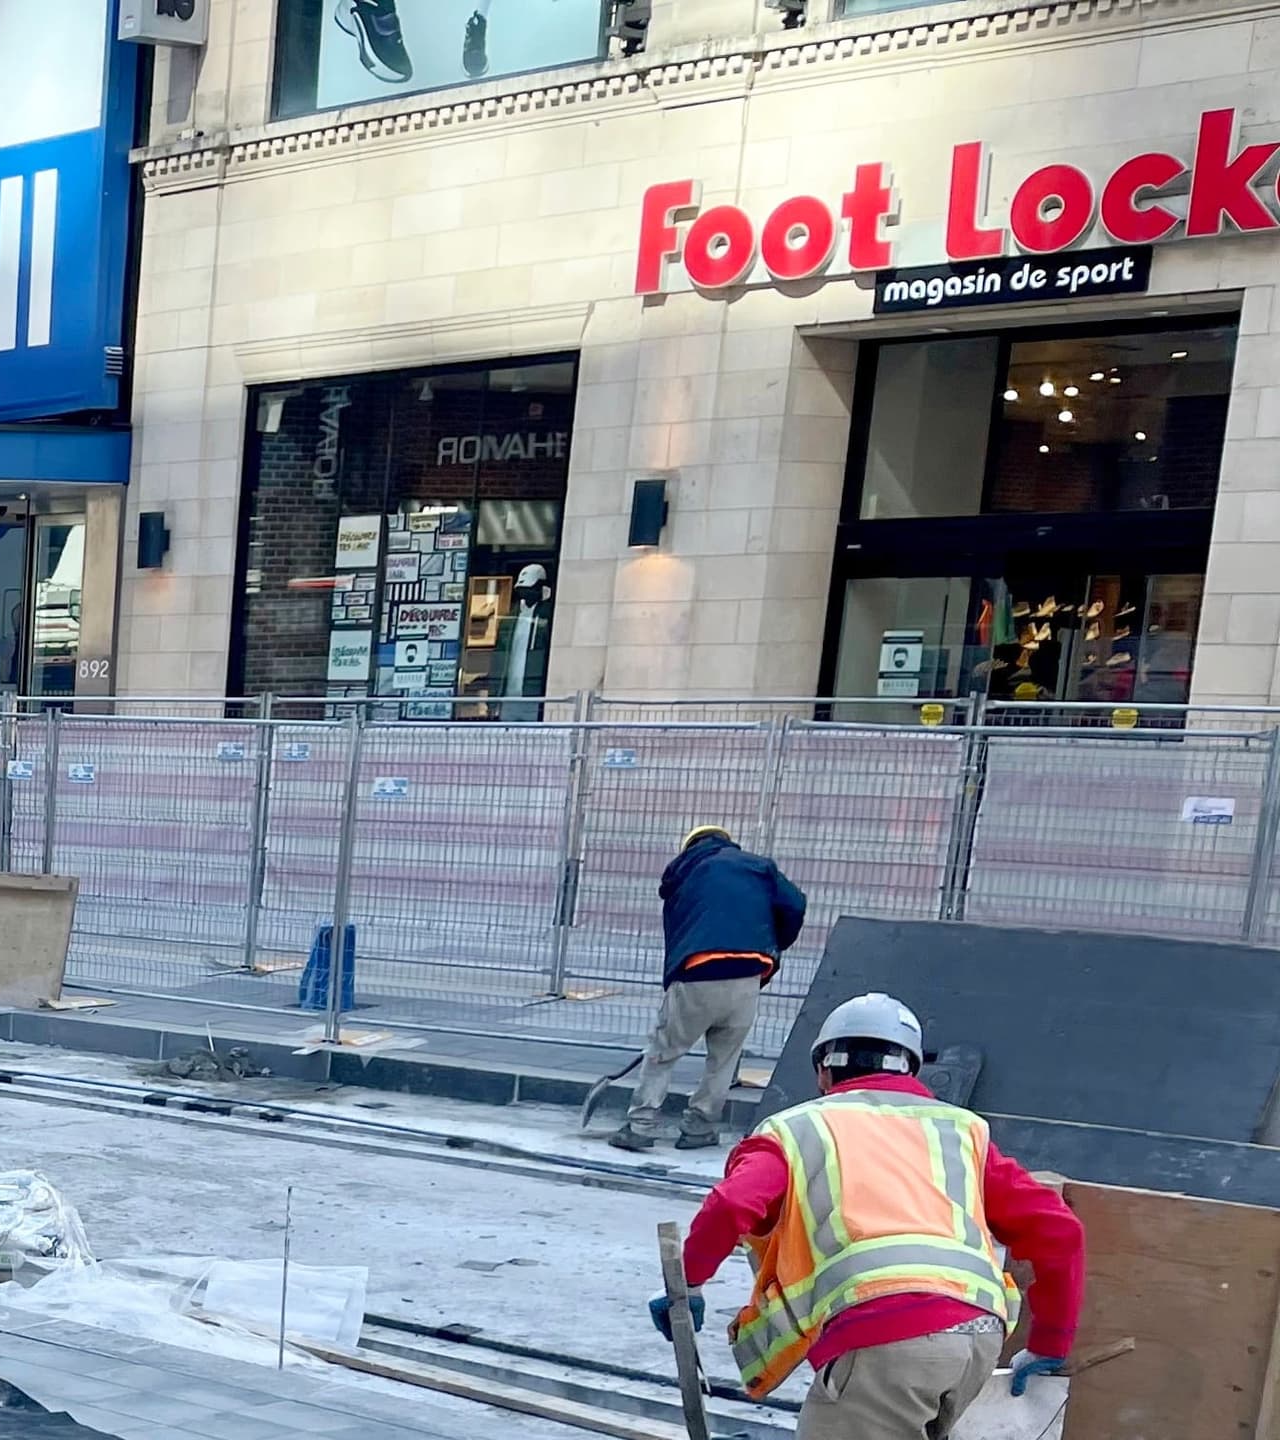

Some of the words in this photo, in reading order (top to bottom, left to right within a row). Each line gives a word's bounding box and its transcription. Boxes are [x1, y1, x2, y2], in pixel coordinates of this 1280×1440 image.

[635, 161, 899, 295] Foot
[946, 107, 1280, 260] Lock
[884, 274, 1003, 306] magasin
[1010, 262, 1047, 290] de
[1055, 257, 1135, 295] sport
[79, 660, 110, 678] 892
